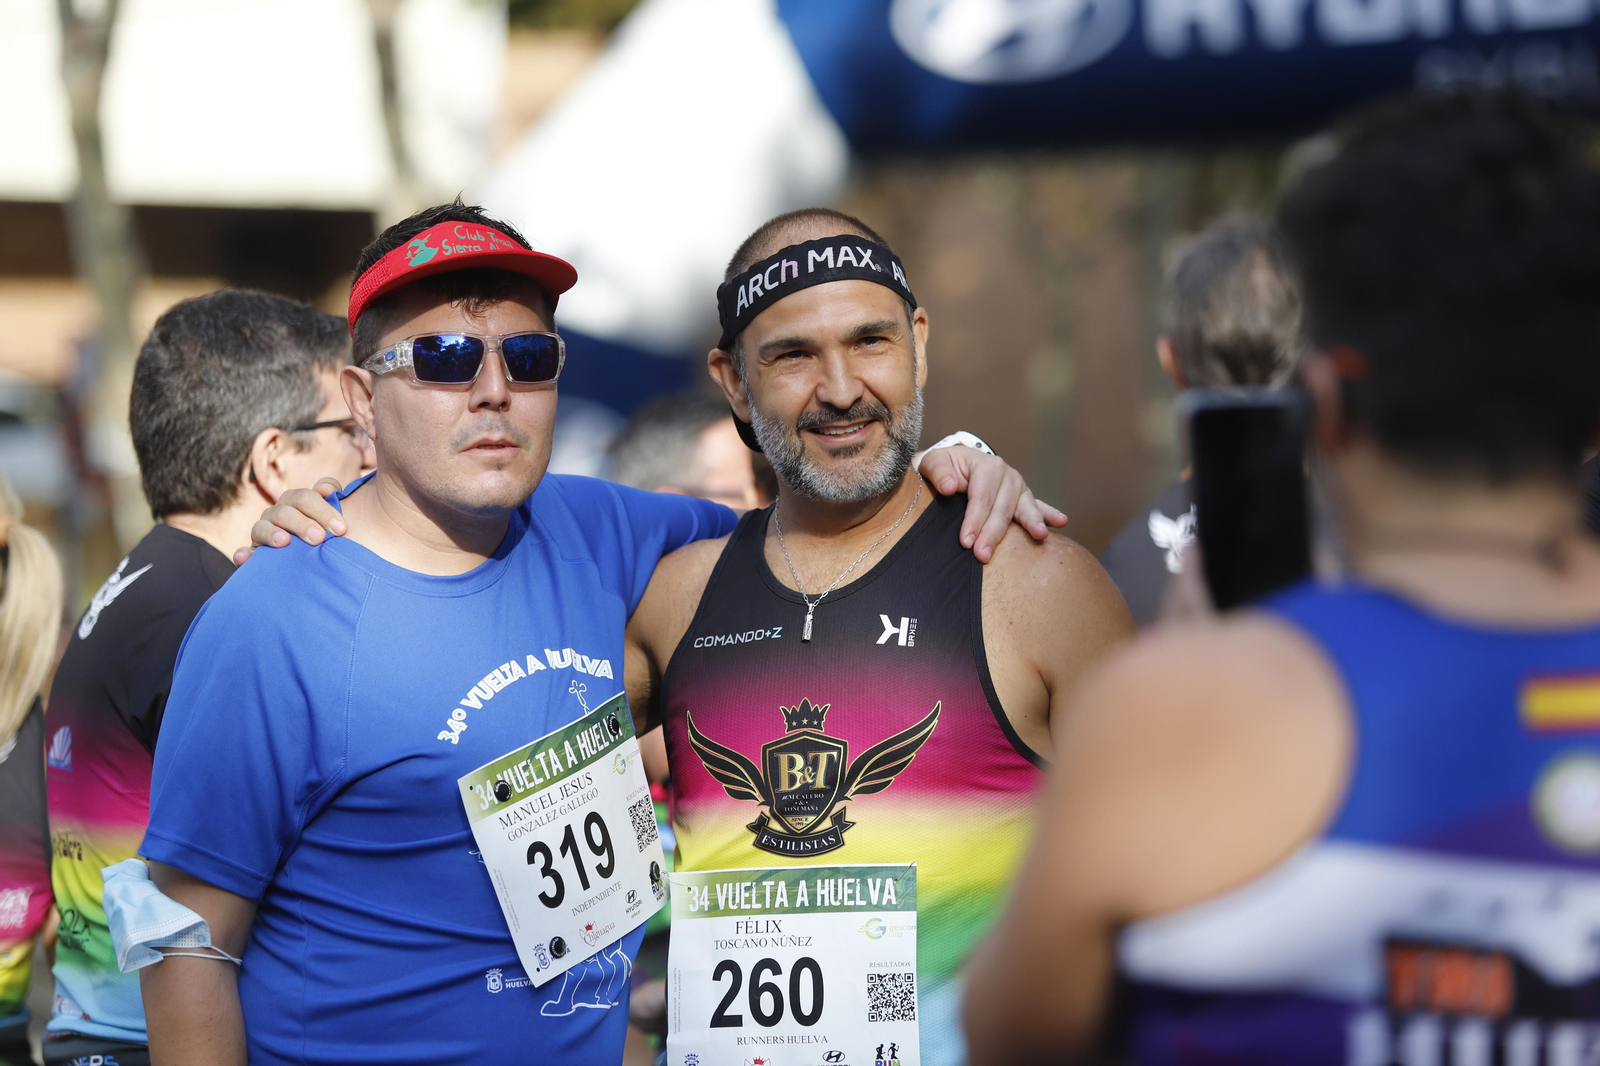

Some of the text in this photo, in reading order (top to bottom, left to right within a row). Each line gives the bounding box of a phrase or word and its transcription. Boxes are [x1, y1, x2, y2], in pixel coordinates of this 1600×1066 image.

[442, 239, 482, 256] Sierra
[454, 225, 485, 241] Club
[459, 660, 527, 710] VUELTA
[526, 654, 547, 676] A
[475, 779, 499, 811] 34
[563, 739, 579, 769] A
[498, 772, 594, 830] MANUEL JESUS
[507, 787, 599, 843] GONZALEZ GALLEGO
[526, 811, 616, 909] 319
[761, 834, 836, 851] ESTILISTAS
[571, 881, 623, 917] INDEPENDIENTE
[689, 877, 897, 912] 34 VUELTA A HUELVA
[714, 935, 813, 950] TOSCANO NÚÑEZ
[735, 917, 783, 935] FÉLIX
[709, 956, 824, 1029] 260
[736, 1034, 828, 1046] RUNNERS HUELVA
